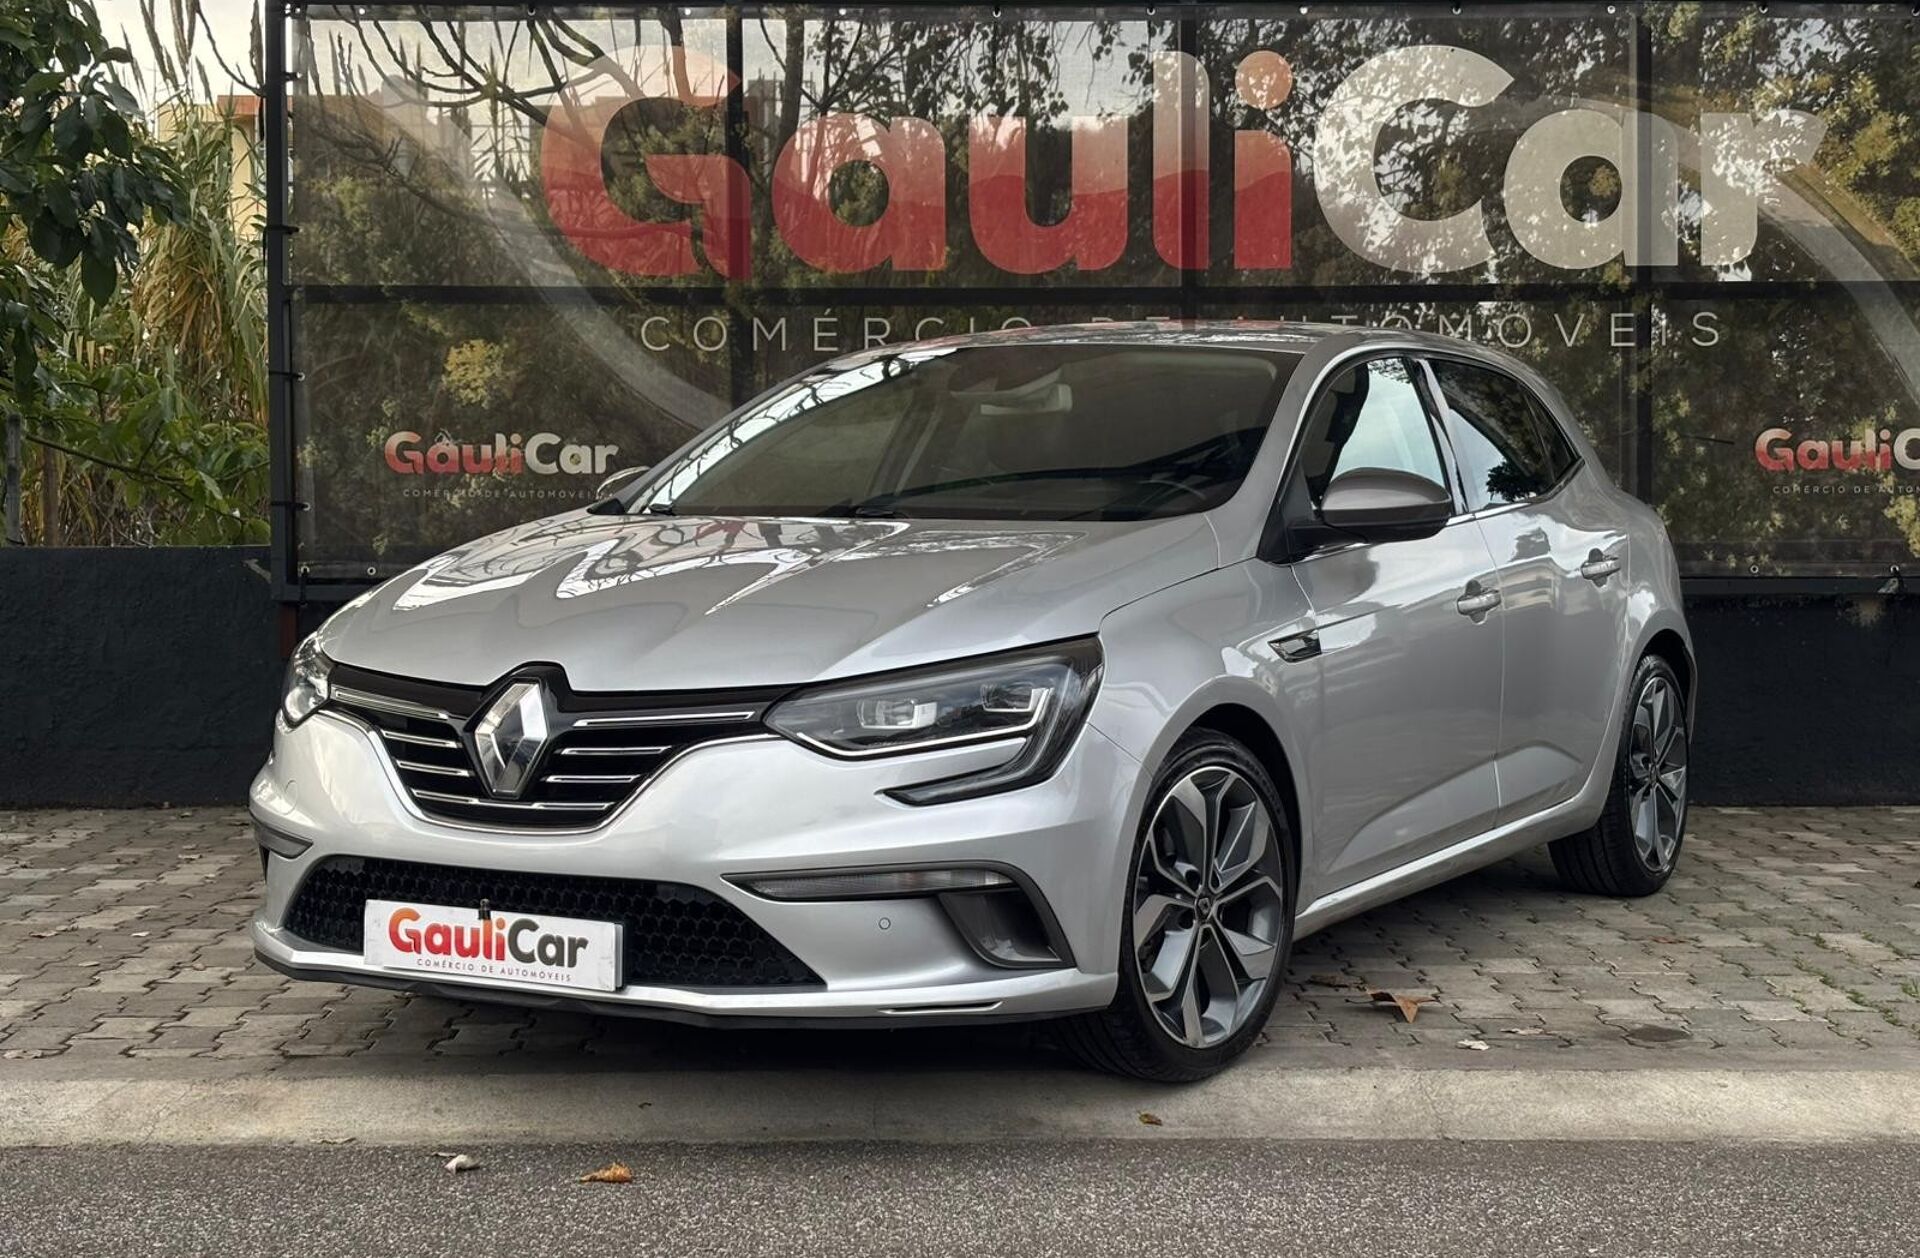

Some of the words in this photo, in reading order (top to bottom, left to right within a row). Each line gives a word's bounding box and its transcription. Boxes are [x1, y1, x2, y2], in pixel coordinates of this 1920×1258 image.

[540, 44, 1827, 280] GauliCar
[384, 430, 620, 476] GauliCar
[484, 488, 501, 498] DE
[1853, 484, 1871, 495] DE
[388, 907, 589, 968] GauliCar
[416, 957, 475, 972] COMÉRCIO
[480, 964, 494, 973] DE
[500, 967, 572, 983] AUTOMÓVEIS
